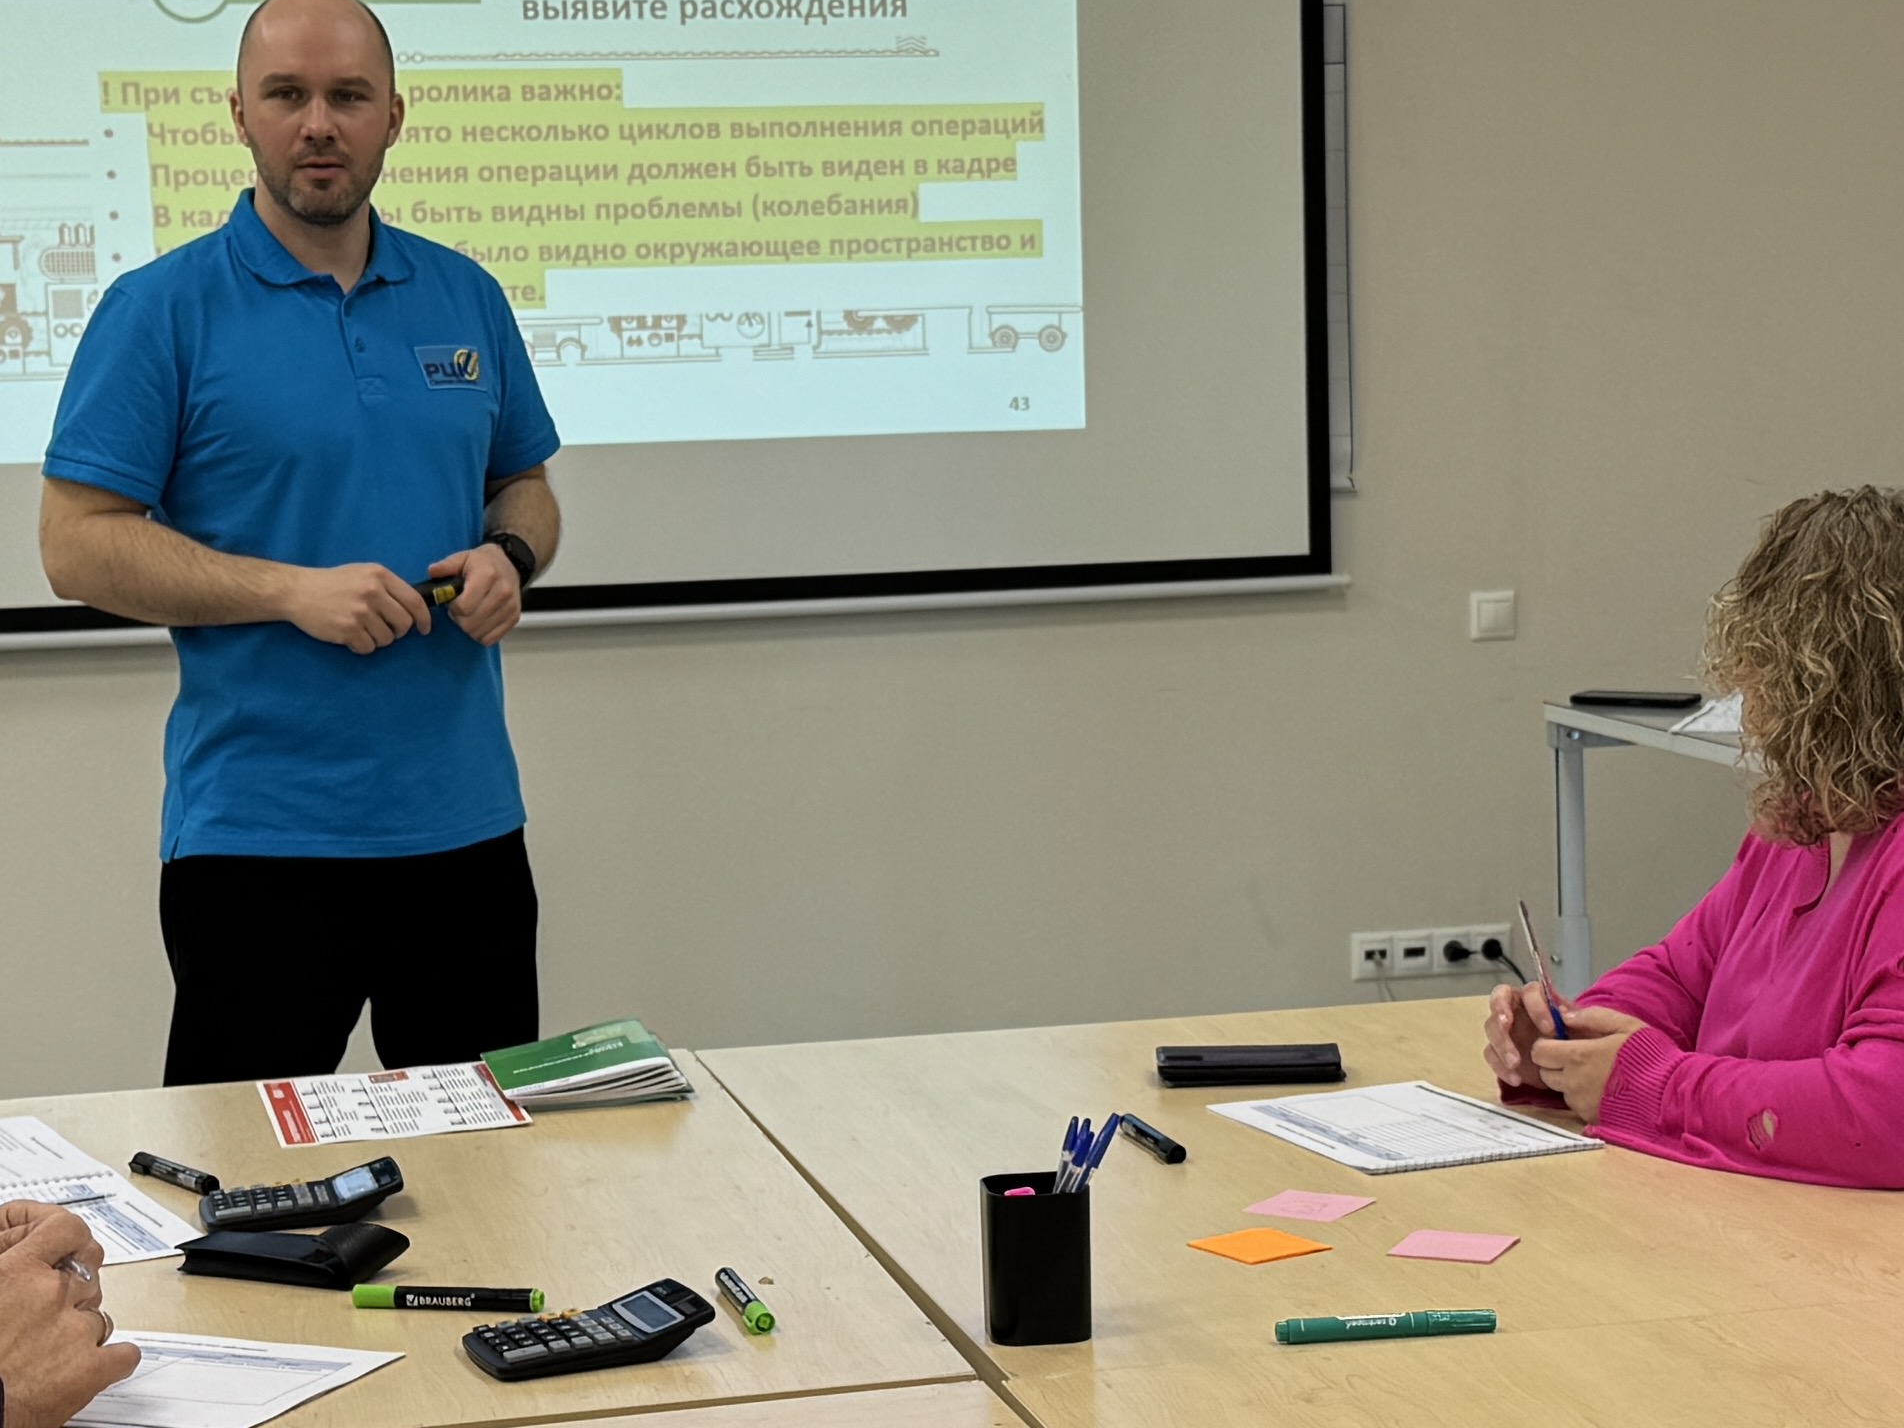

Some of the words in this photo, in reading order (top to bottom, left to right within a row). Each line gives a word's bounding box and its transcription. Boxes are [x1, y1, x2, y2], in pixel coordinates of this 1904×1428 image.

[102, 80, 110, 106] !
[121, 81, 182, 111] При
[408, 82, 512, 107] ролика
[521, 81, 623, 103] важно:
[462, 122, 610, 144] несколько
[618, 119, 722, 145] циклов
[730, 114, 904, 140] выполнения
[910, 110, 1046, 142] операций
[477, 162, 619, 187] операции
[627, 158, 737, 186] должен
[745, 154, 813, 178] быть
[822, 155, 905, 181] виден
[914, 157, 929, 176] в
[935, 153, 1018, 181] кадре
[153, 205, 172, 228] В
[411, 199, 483, 223] быть
[491, 203, 586, 228] видны
[595, 194, 743, 224] проблемы
[751, 191, 920, 223] (колебания)
[538, 242, 627, 267] видно
[634, 236, 822, 265] окружающее
[829, 231, 1012, 259] пространство
[1020, 233, 1037, 252] и
[1008, 396, 1031, 413] 43
[419, 1295, 472, 1308] BRAUBERG
